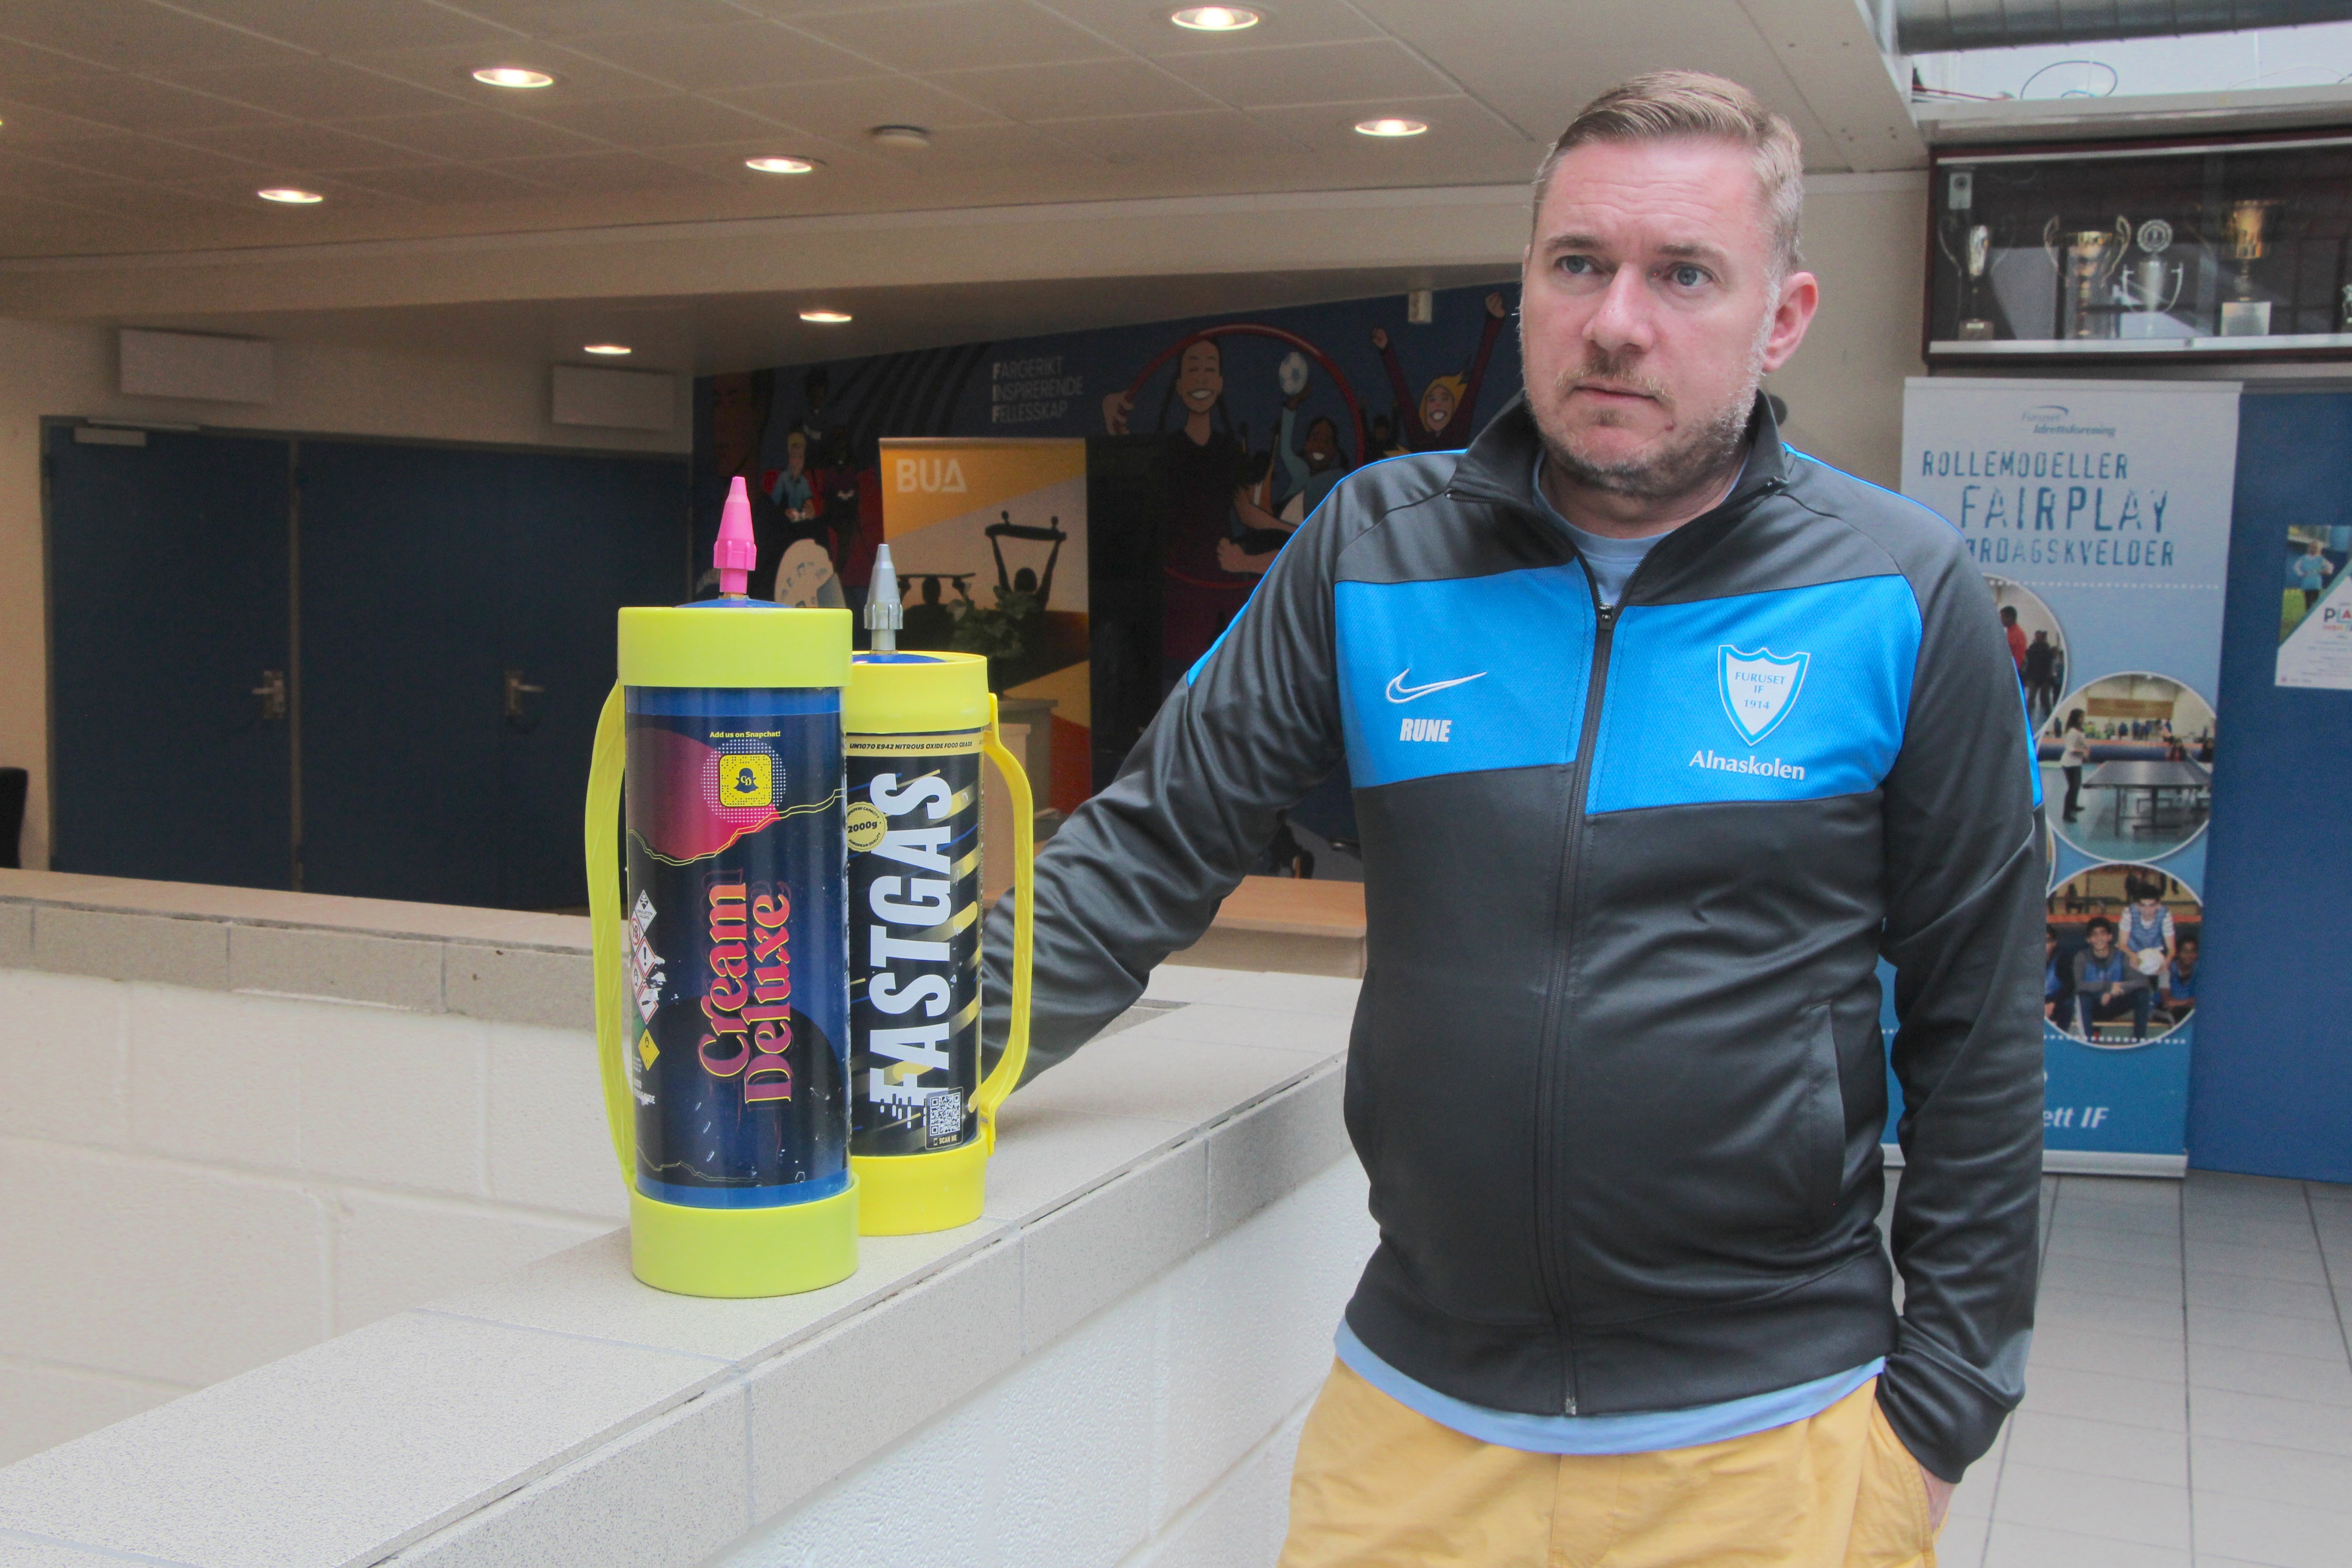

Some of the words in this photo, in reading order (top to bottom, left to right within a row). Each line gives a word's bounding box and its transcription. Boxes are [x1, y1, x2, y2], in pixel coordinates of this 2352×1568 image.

[992, 399, 1068, 423] FELLESSKAP
[897, 459, 967, 493] BUA
[1922, 450, 2128, 480] ROLLEMODELLER
[1960, 485, 2168, 534] FAIRPLAY
[1735, 672, 1786, 684] FURUSET
[1754, 685, 1764, 693] IF
[1744, 700, 1770, 709] 1914
[1399, 718, 1452, 744] RUNE
[1689, 750, 1805, 781] Alnaskolen
[863, 807, 879, 818] CAPACITY
[848, 821, 877, 833] 2000g
[868, 832, 881, 846] QUALITY
[869, 773, 951, 1107] FASTGAS
[699, 882, 750, 1077] Cream
[741, 894, 792, 1103] Deluxe
[2081, 1107, 2110, 1128] IF
[939, 1136, 951, 1145] SCAN
[951, 1134, 957, 1142] ME
